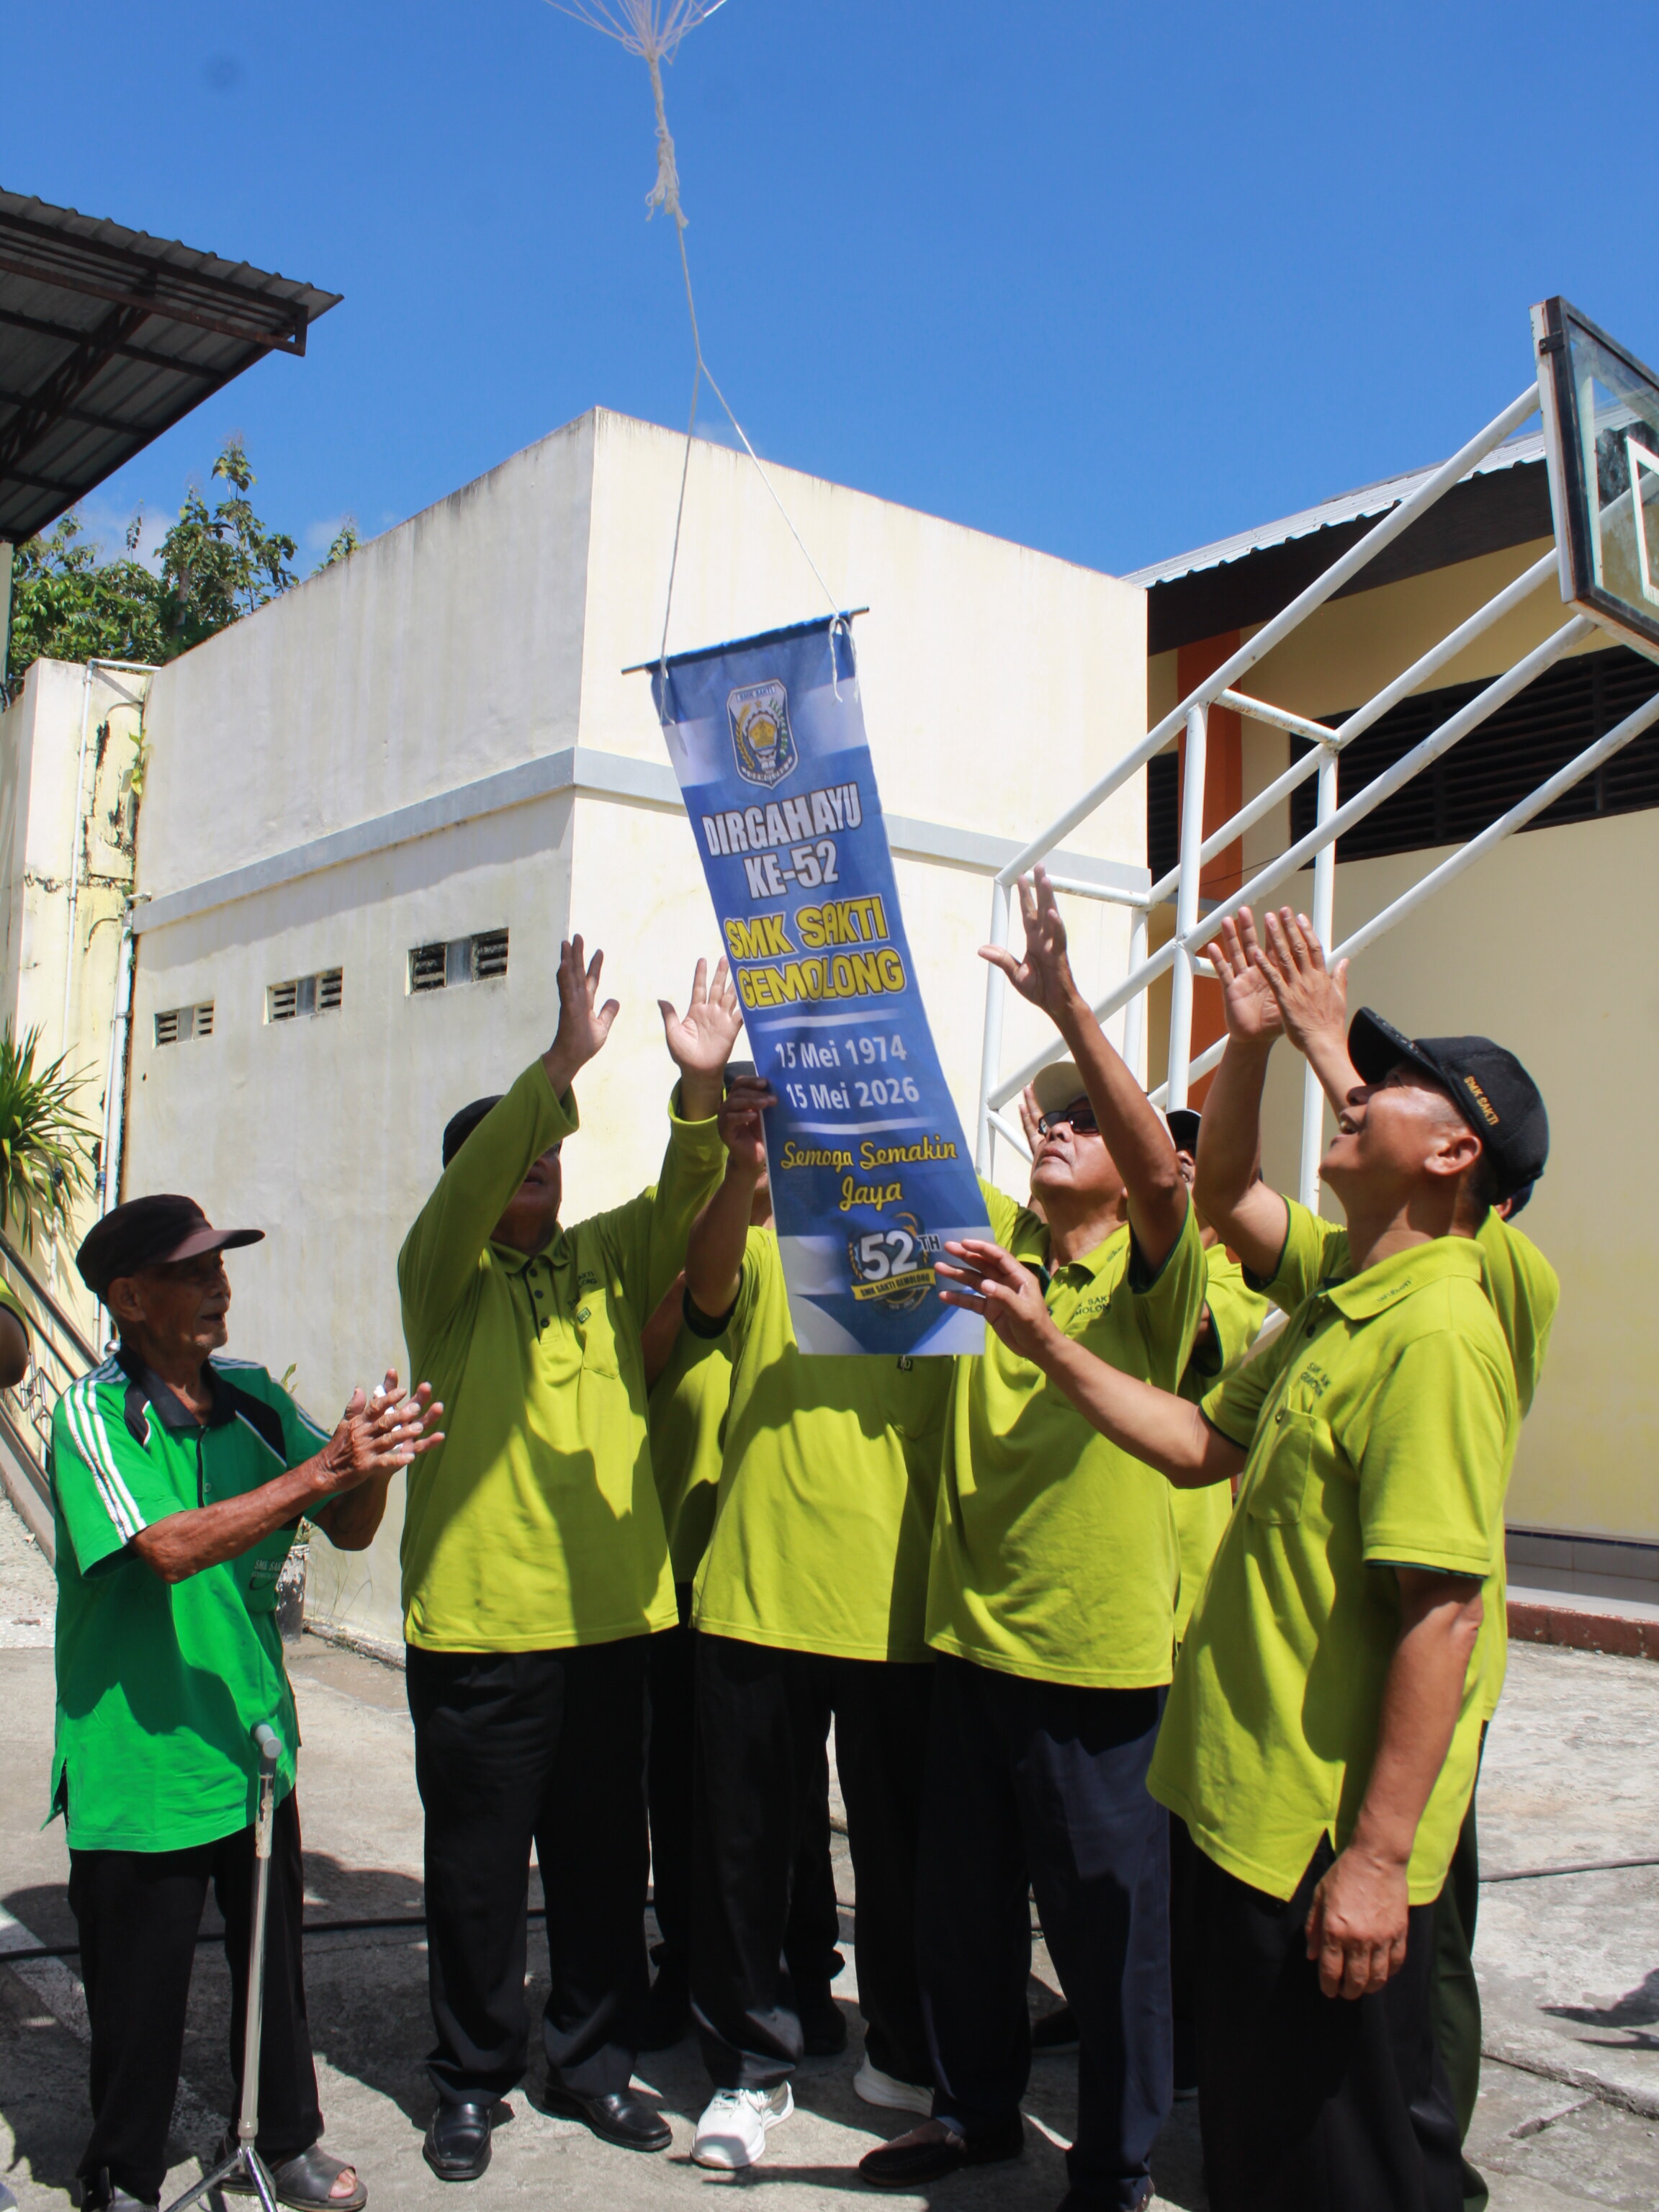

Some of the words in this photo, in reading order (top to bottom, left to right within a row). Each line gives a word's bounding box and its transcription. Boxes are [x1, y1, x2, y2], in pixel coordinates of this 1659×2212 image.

[702, 782, 862, 856] DIRGAHAYU
[743, 840, 839, 899] KE-52
[724, 914, 795, 960] SMK
[796, 894, 889, 949] SAKTI
[737, 950, 905, 1010] GEMOLONG
[775, 1043, 796, 1069] 15
[801, 1039, 840, 1069] Mei
[845, 1035, 907, 1065] 1974
[786, 1083, 807, 1109] 15
[811, 1081, 850, 1110] Mei
[854, 1077, 920, 1107] 2026
[1464, 1076, 1483, 1097] SMK
[1477, 1097, 1499, 1125] SAKTI
[781, 1141, 853, 1172] Semoga
[859, 1136, 958, 1171] Semakin
[839, 1174, 904, 1211] Jaya
[860, 1230, 917, 1281] 52
[917, 1233, 942, 1252] TH
[860, 1287, 876, 1298] SMK
[876, 1280, 896, 1293] SAKTI
[895, 1272, 930, 1287] GEMOLONG
[1087, 1295, 1108, 1305] SAK
